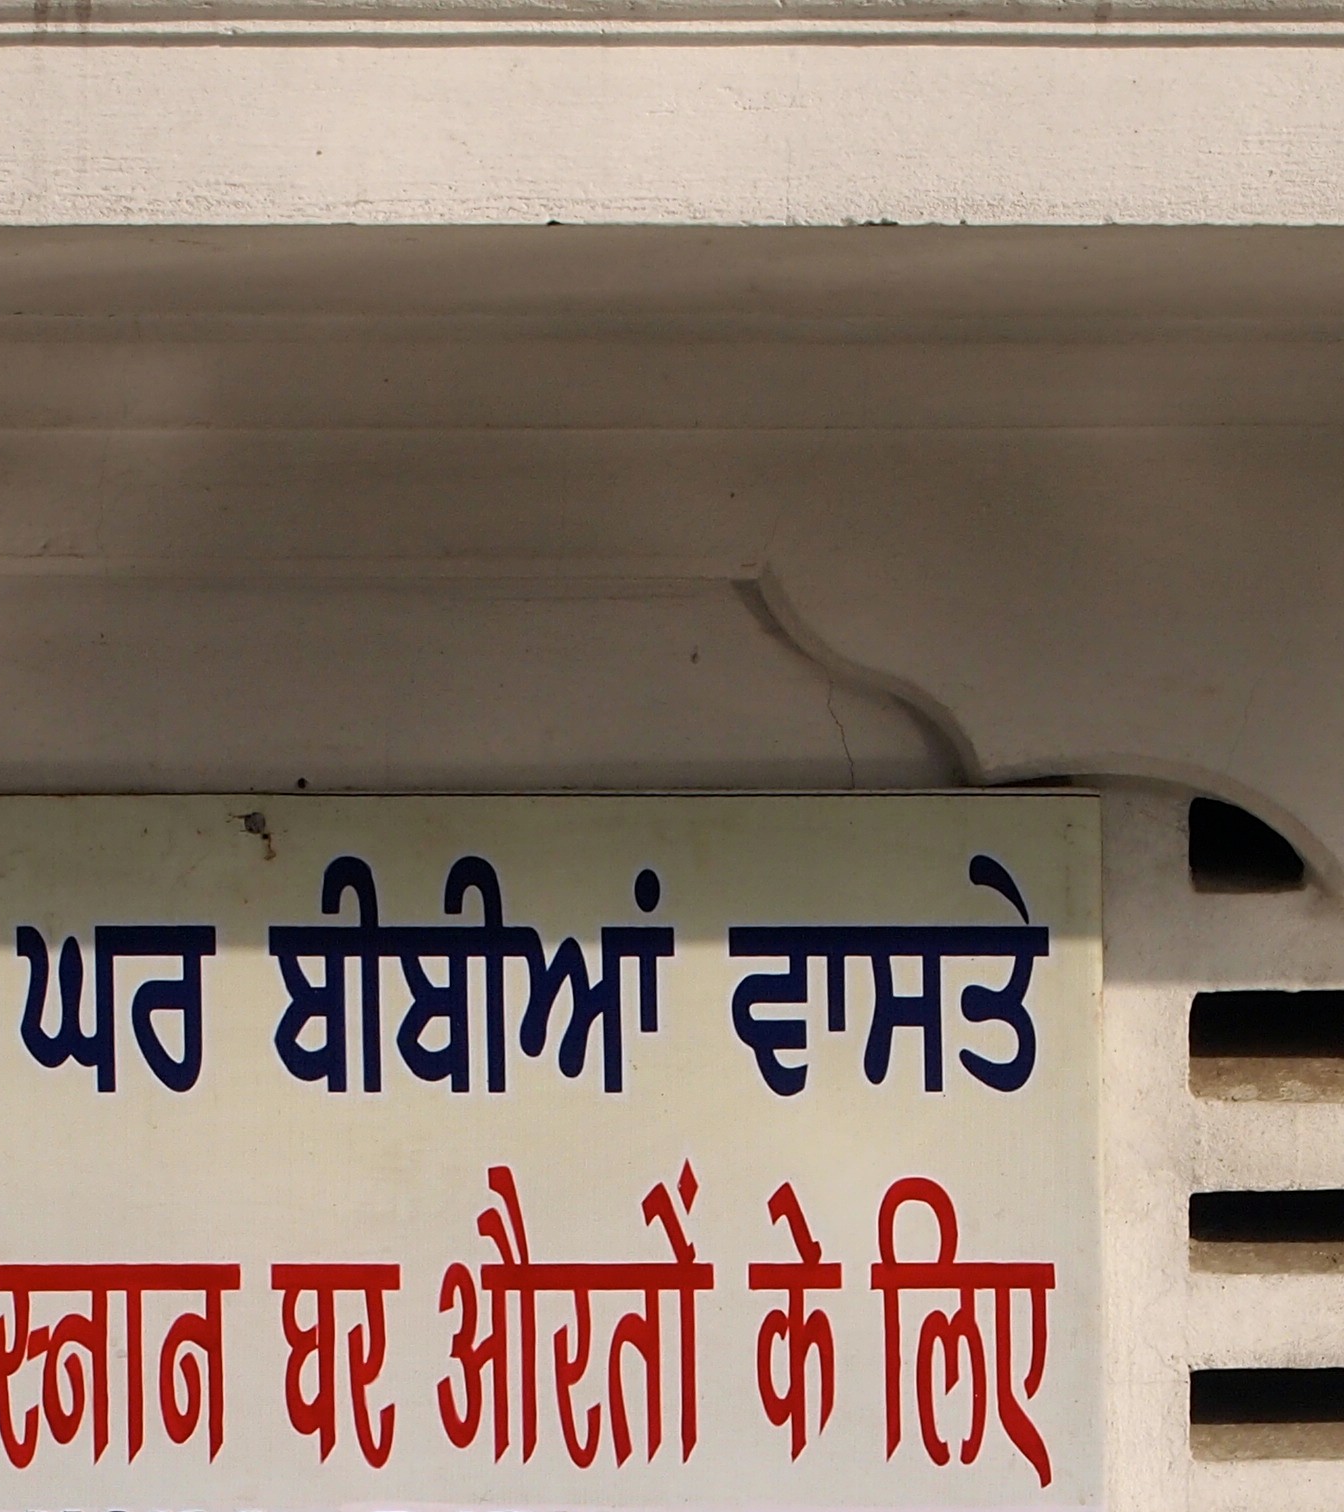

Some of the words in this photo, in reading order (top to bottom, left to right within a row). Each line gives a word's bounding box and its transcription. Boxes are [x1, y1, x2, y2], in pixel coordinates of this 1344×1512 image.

[16, 925, 216, 1093] ਘਰ
[269, 855, 675, 1093] ਬੀਬੀਆਂ
[728, 854, 1049, 1096] ਵਾਸਤੇ
[271, 1263, 401, 1469] घर
[437, 1160, 715, 1469] औरतों
[748, 1182, 843, 1460] के
[871, 1177, 1056, 1487] लिए
